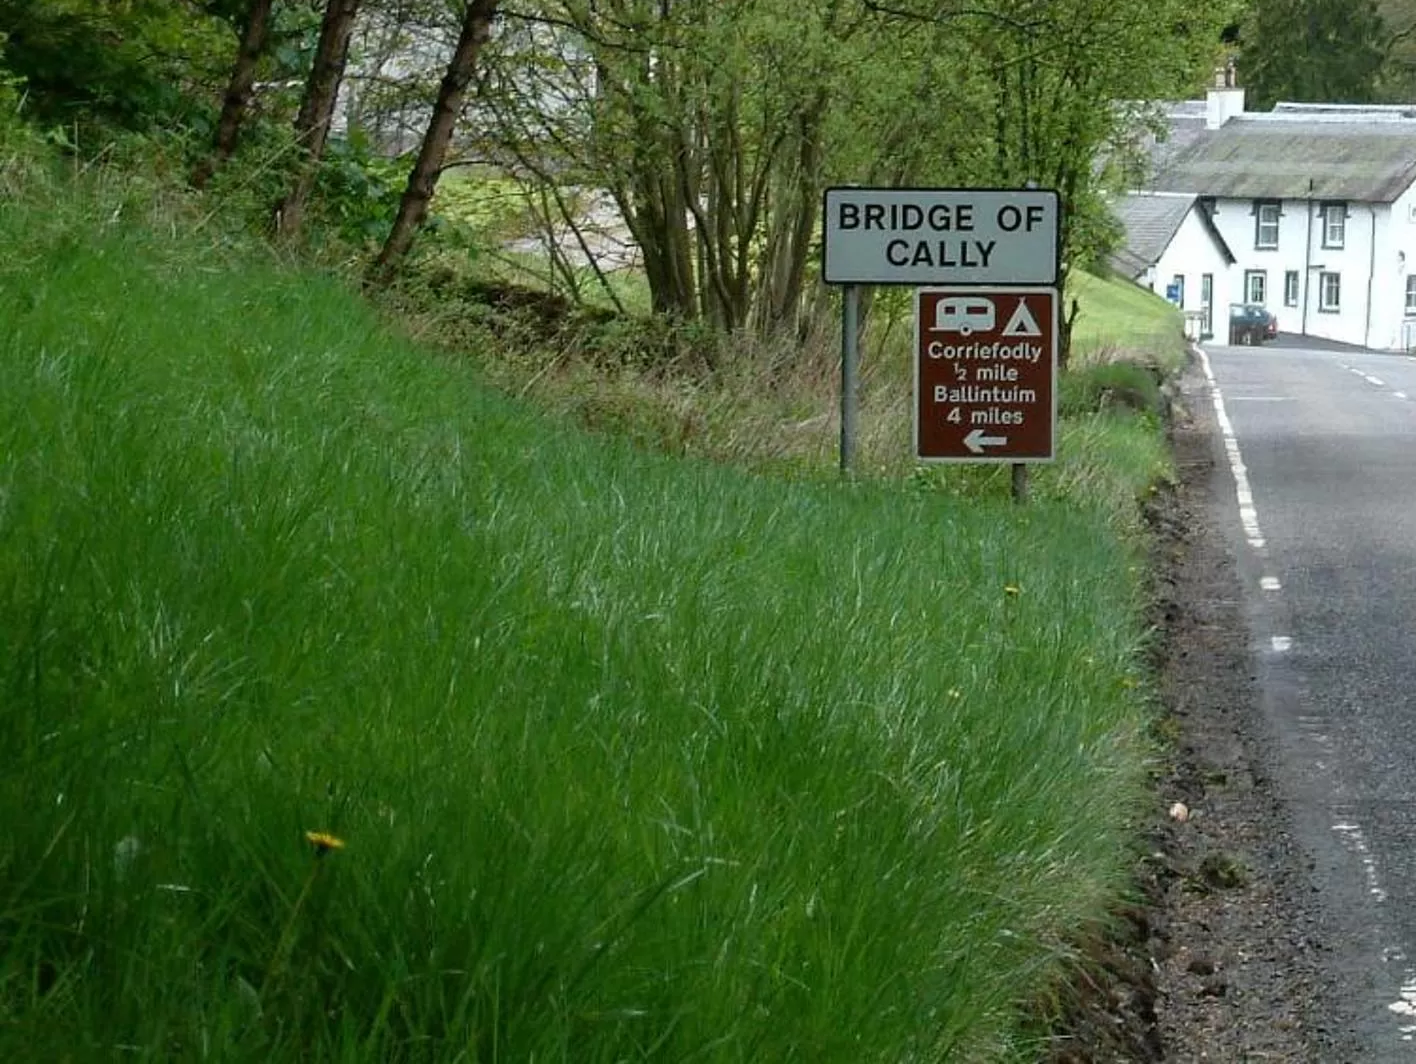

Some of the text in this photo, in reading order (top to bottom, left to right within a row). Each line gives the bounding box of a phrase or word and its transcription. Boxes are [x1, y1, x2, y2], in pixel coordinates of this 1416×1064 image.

[839, 203, 1044, 232] BRIDGE OF
[886, 239, 996, 268] CALLY
[928, 340, 1042, 362] Corriefodly
[976, 364, 1019, 382] mile
[934, 386, 1036, 403] Ballintuim
[947, 407, 1024, 425] 4 miles
